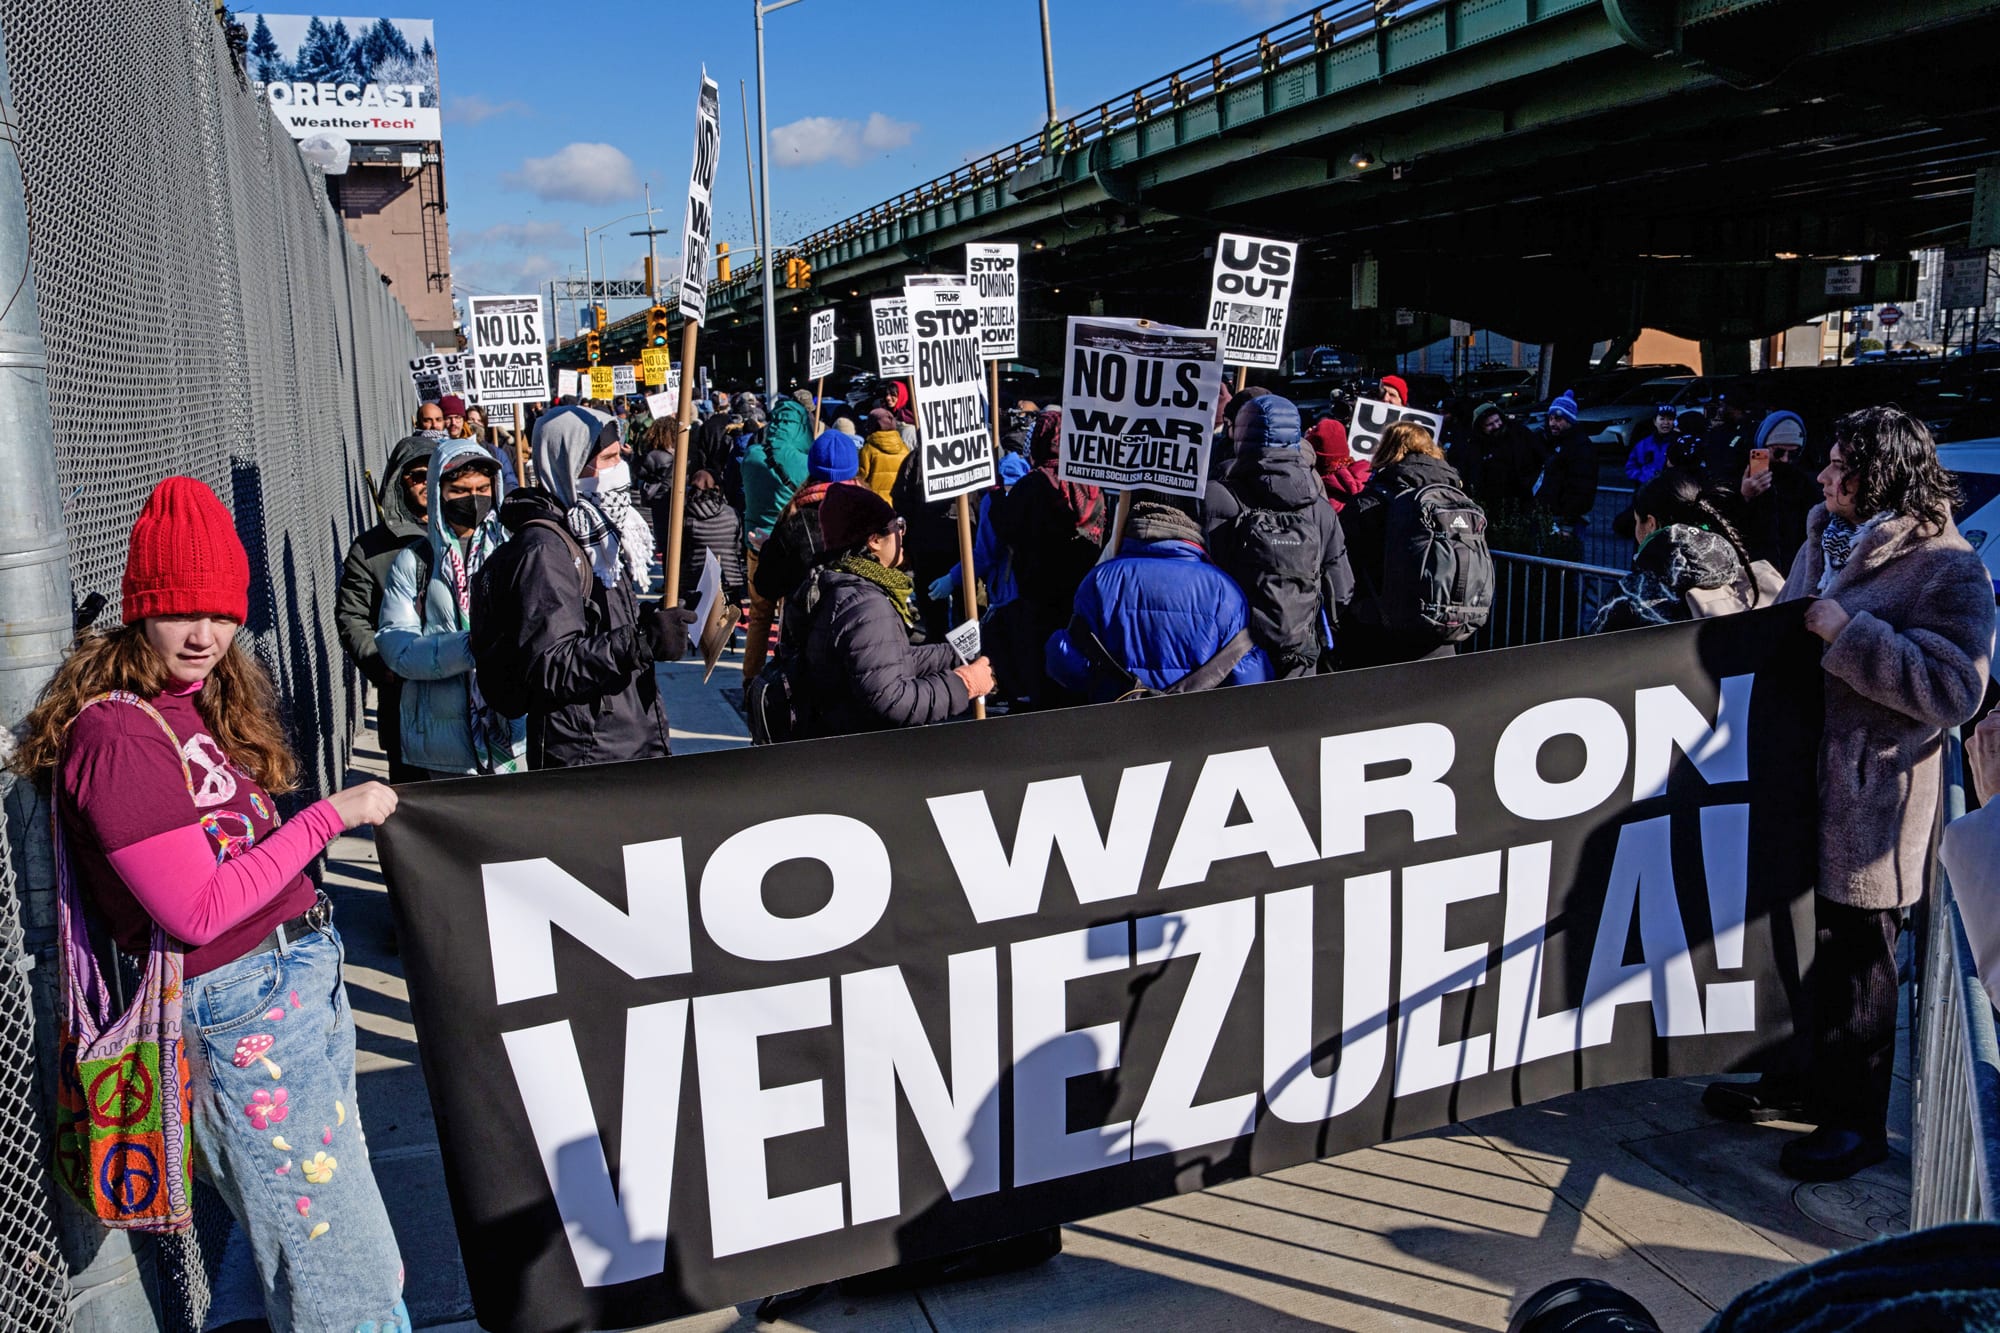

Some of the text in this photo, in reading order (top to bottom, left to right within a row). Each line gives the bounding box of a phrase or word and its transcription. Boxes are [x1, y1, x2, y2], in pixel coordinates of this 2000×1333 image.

[291, 117, 414, 129] WeatherTech
[970, 257, 1014, 272] STOP
[1222, 238, 1291, 276] US
[1217, 273, 1288, 300] OUT
[935, 292, 960, 303] TRUMP
[817, 314, 831, 324] NO
[875, 306, 908, 318] STO
[980, 306, 1014, 327] ENEZUELA
[1212, 301, 1284, 327] OF THE
[475, 314, 541, 347] NO U.S.
[914, 308, 978, 338] STOP
[410, 356, 441, 371] US
[479, 352, 543, 368] WAR
[644, 356, 655, 367] NO
[812, 348, 824, 366] FOR
[918, 336, 982, 389] BOMBING
[480, 368, 544, 389] VENEZUELA
[591, 372, 613, 383] NEEDS
[614, 372, 622, 380] NO
[1072, 348, 1208, 411] NO U.S.
[921, 395, 986, 440] VENEZUELA
[1070, 408, 1204, 446] WAR
[1122, 435, 1146, 443] ON
[926, 433, 989, 470] NOW!
[1068, 433, 1198, 475] VENEZUELA
[929, 477, 944, 491] PARTY
[1067, 465, 1195, 489] PARTY FOR SOCIALISM & LIBERATION
[482, 674, 1753, 1005] NO WAR ON
[501, 803, 1755, 1288] VENEZUELA!
